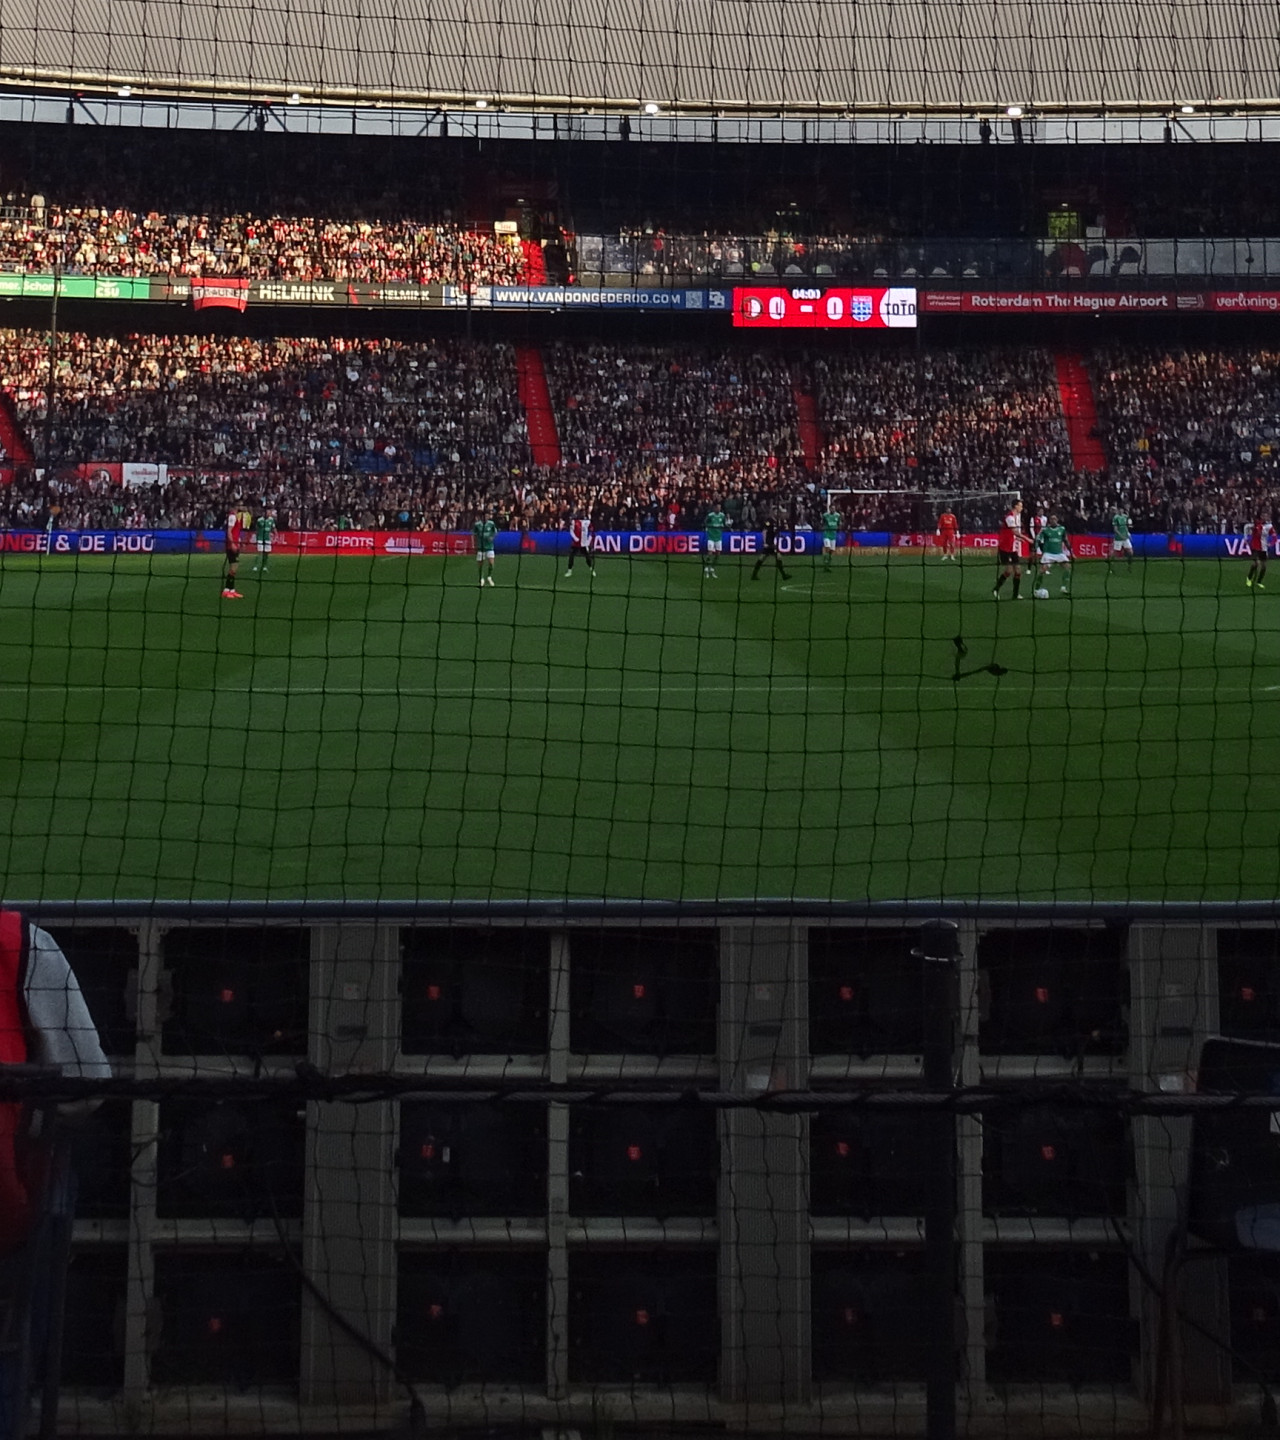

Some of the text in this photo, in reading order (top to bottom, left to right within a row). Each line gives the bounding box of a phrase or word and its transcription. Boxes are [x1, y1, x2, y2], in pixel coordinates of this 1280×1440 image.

[96, 286, 120, 298] CSU
[259, 284, 335, 302] HELMINK
[769, 296, 786, 320] 0
[826, 296, 844, 320] 0
[971, 295, 1042, 307] Rotterdam
[1045, 295, 1070, 307] The
[1073, 295, 1116, 310] Hague
[1119, 295, 1168, 310] Airport
[55, 534, 70, 551] &
[79, 534, 105, 552] DE
[325, 535, 374, 548] DEPOTS
[629, 534, 699, 553] DONGE
[729, 535, 757, 553] DE
[1079, 544, 1098, 556] SEA
